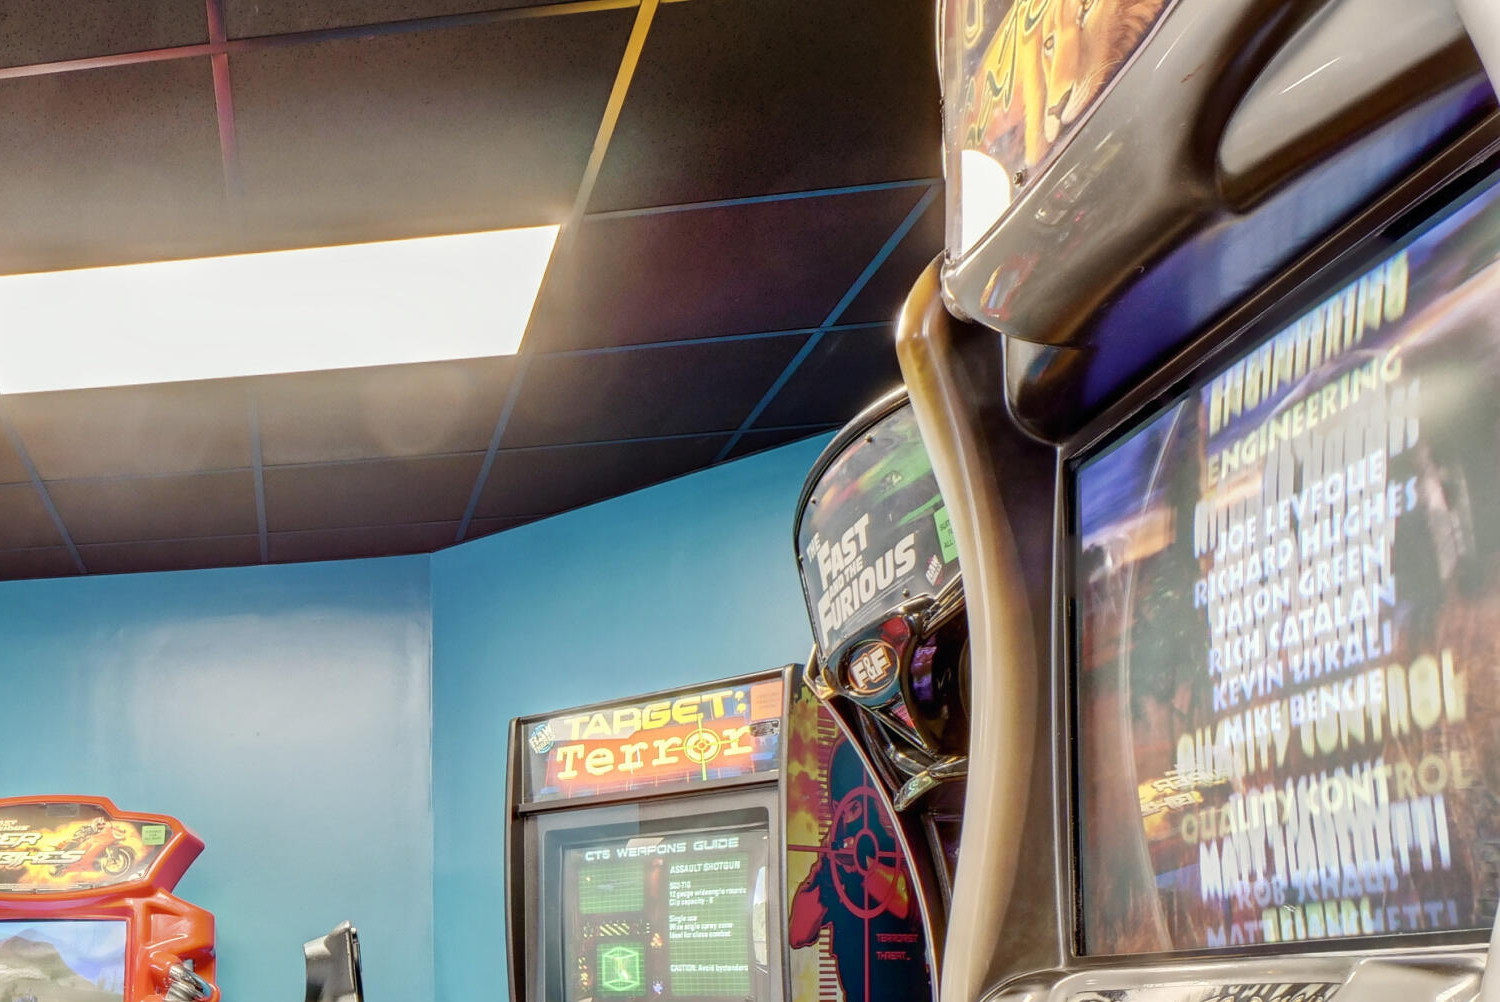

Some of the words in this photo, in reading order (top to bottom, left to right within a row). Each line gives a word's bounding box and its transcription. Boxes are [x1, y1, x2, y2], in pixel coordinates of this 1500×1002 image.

[1207, 345, 1403, 486] ENGINEERING
[806, 532, 826, 563] THE
[817, 512, 870, 592] FAST
[1193, 537, 1294, 610] RICHARD
[1300, 475, 1418, 560] HUGHES
[1214, 516, 1257, 561] JOE
[817, 532, 918, 651] FURIOUS
[1213, 576, 1291, 638] JASON
[1298, 535, 1384, 600] GREEN
[1208, 627, 1261, 677] RICH
[1269, 576, 1396, 656] CATALAN
[850, 645, 891, 688] F&F
[1213, 660, 1284, 712] KEVIN
[1223, 700, 1282, 749] MIKE
[616, 842, 687, 857] WEAPONS
[693, 837, 740, 851] GUIDE
[669, 864, 703, 874] ASSAULT
[704, 860, 741, 871] SHOTGUN
